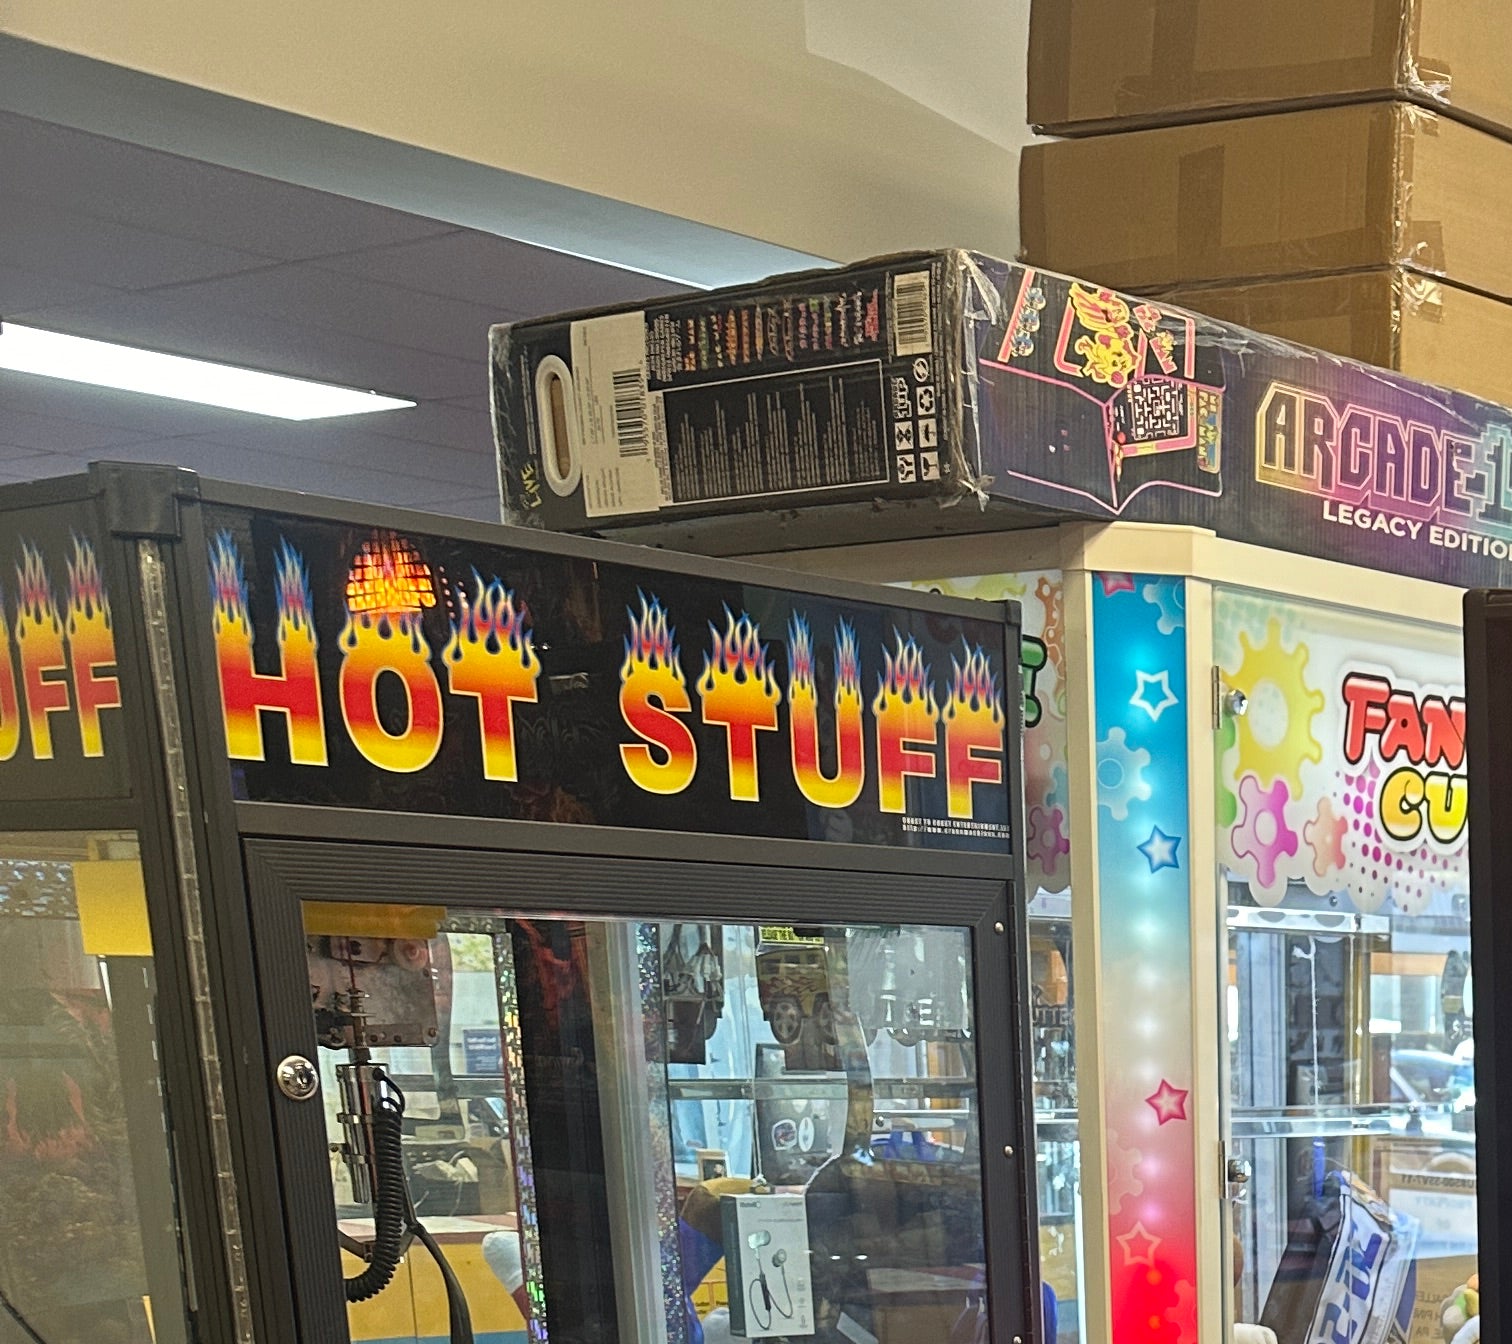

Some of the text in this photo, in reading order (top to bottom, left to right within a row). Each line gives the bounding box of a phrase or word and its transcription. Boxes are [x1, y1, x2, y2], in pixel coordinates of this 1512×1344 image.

[1322, 499, 1423, 542] LEGACY
[206, 545, 1006, 820] HOT STUFF
